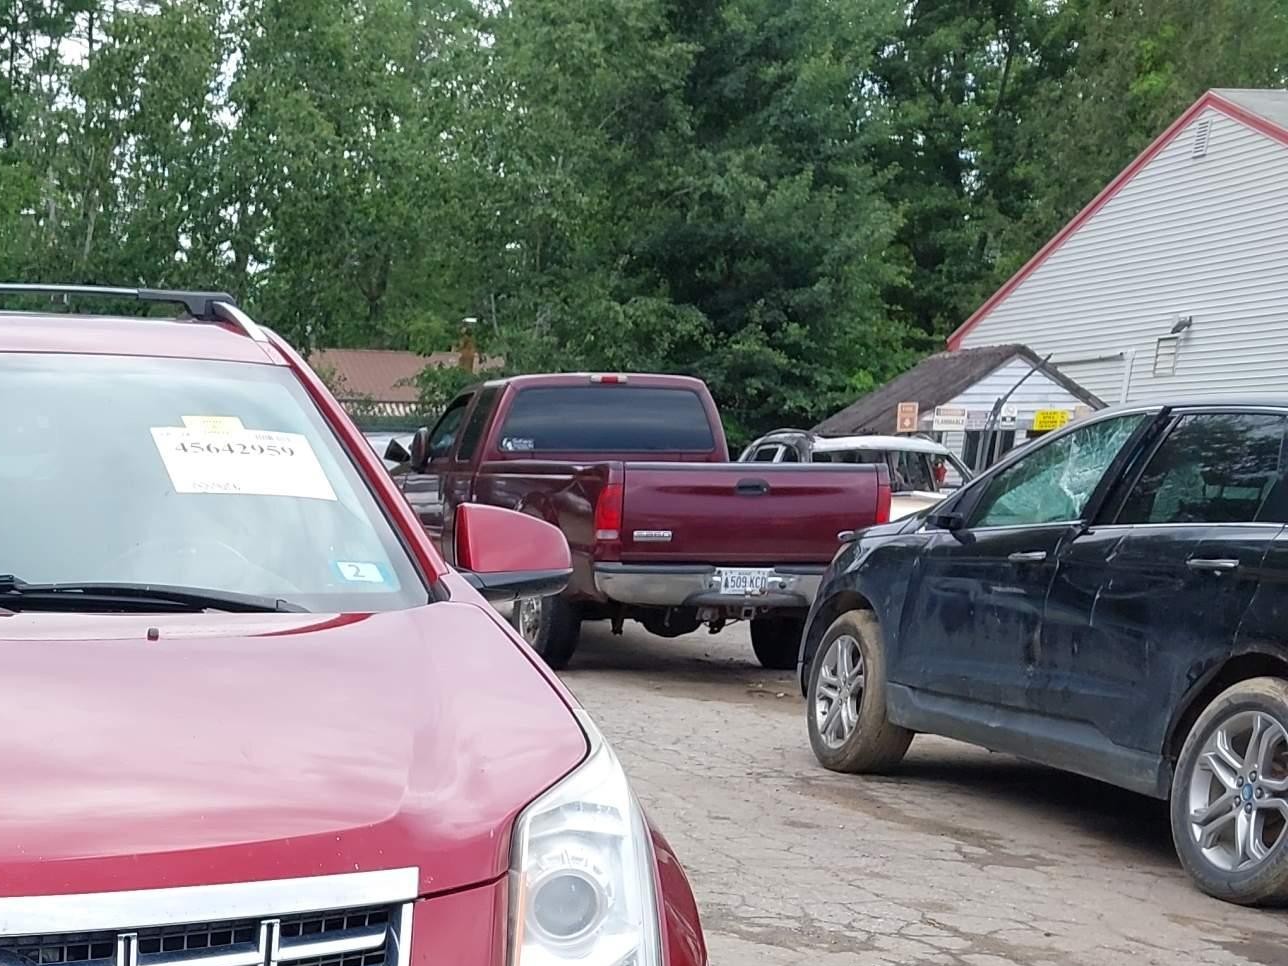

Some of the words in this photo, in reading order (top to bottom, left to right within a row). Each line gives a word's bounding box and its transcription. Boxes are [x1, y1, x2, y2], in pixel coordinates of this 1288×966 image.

[175, 441, 296, 457] 45642959
[346, 563, 367, 578] 2
[730, 575, 748, 589] 509
